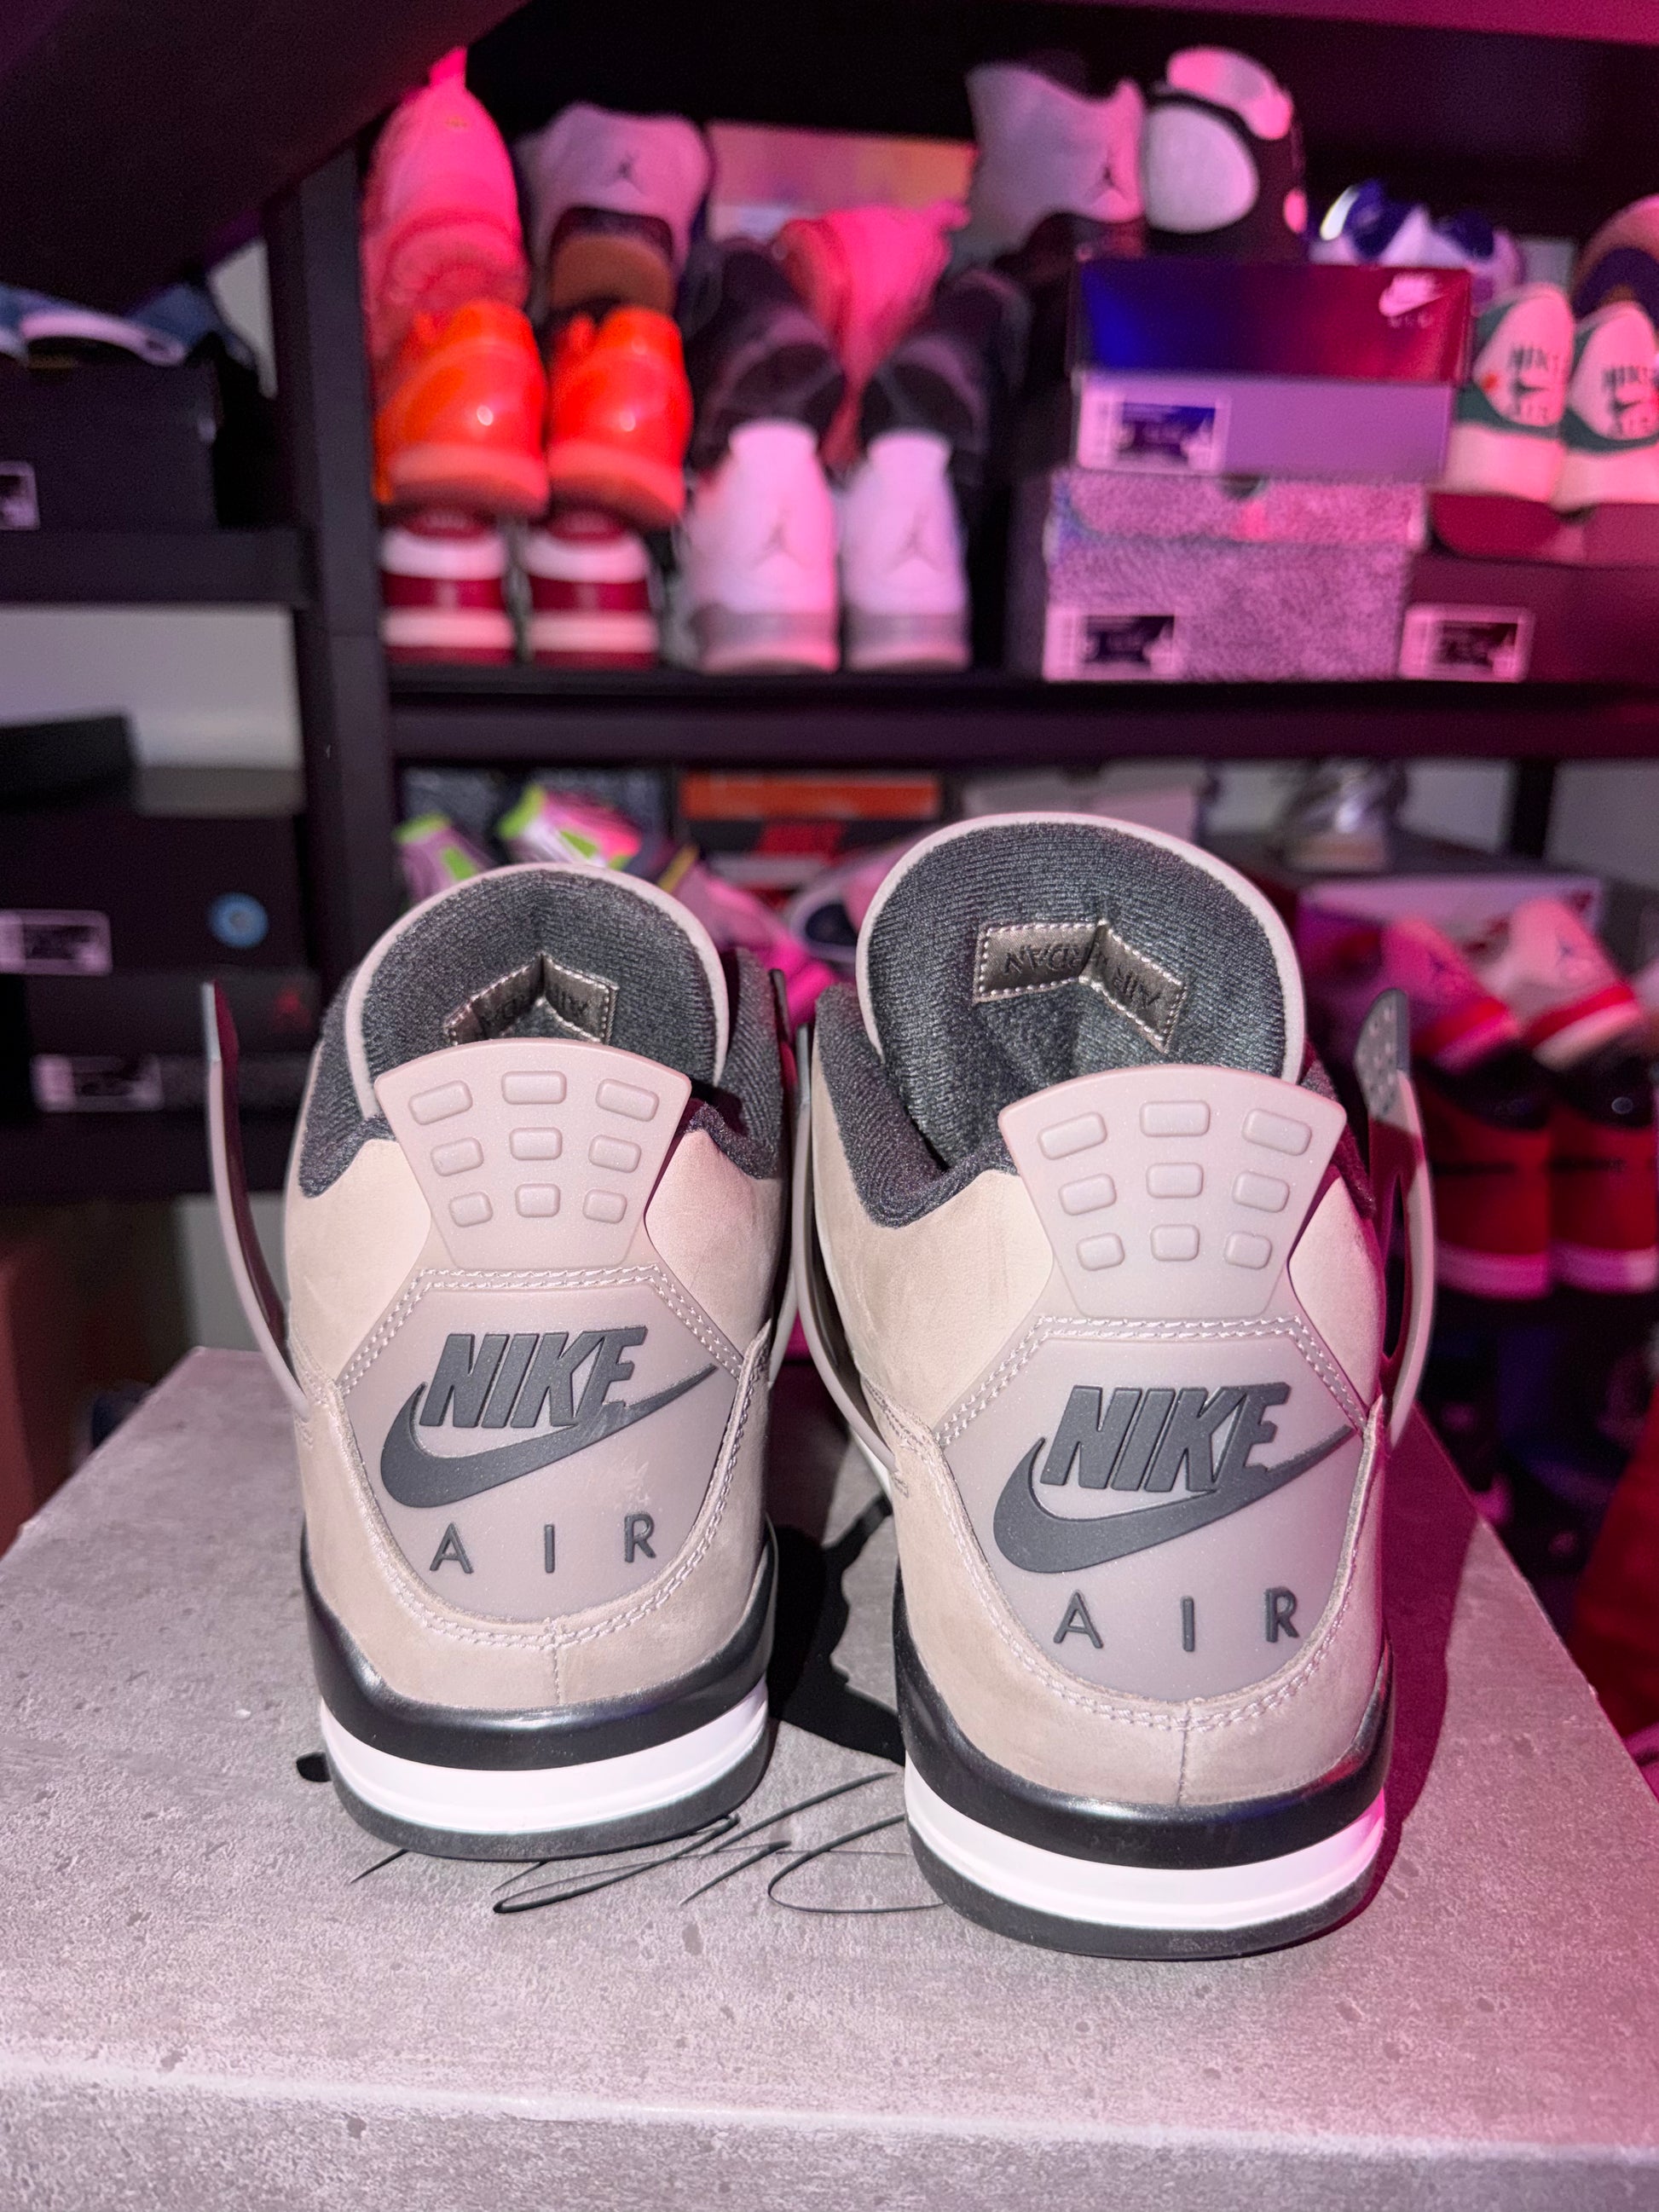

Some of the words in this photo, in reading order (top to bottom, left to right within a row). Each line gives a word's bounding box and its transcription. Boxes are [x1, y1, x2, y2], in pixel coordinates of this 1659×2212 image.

[419, 1325, 648, 1429] NIKE
[1040, 1382, 1292, 1493] NIKE
[429, 1510, 656, 1575] AIR
[1053, 1585, 1300, 1653] AIR
